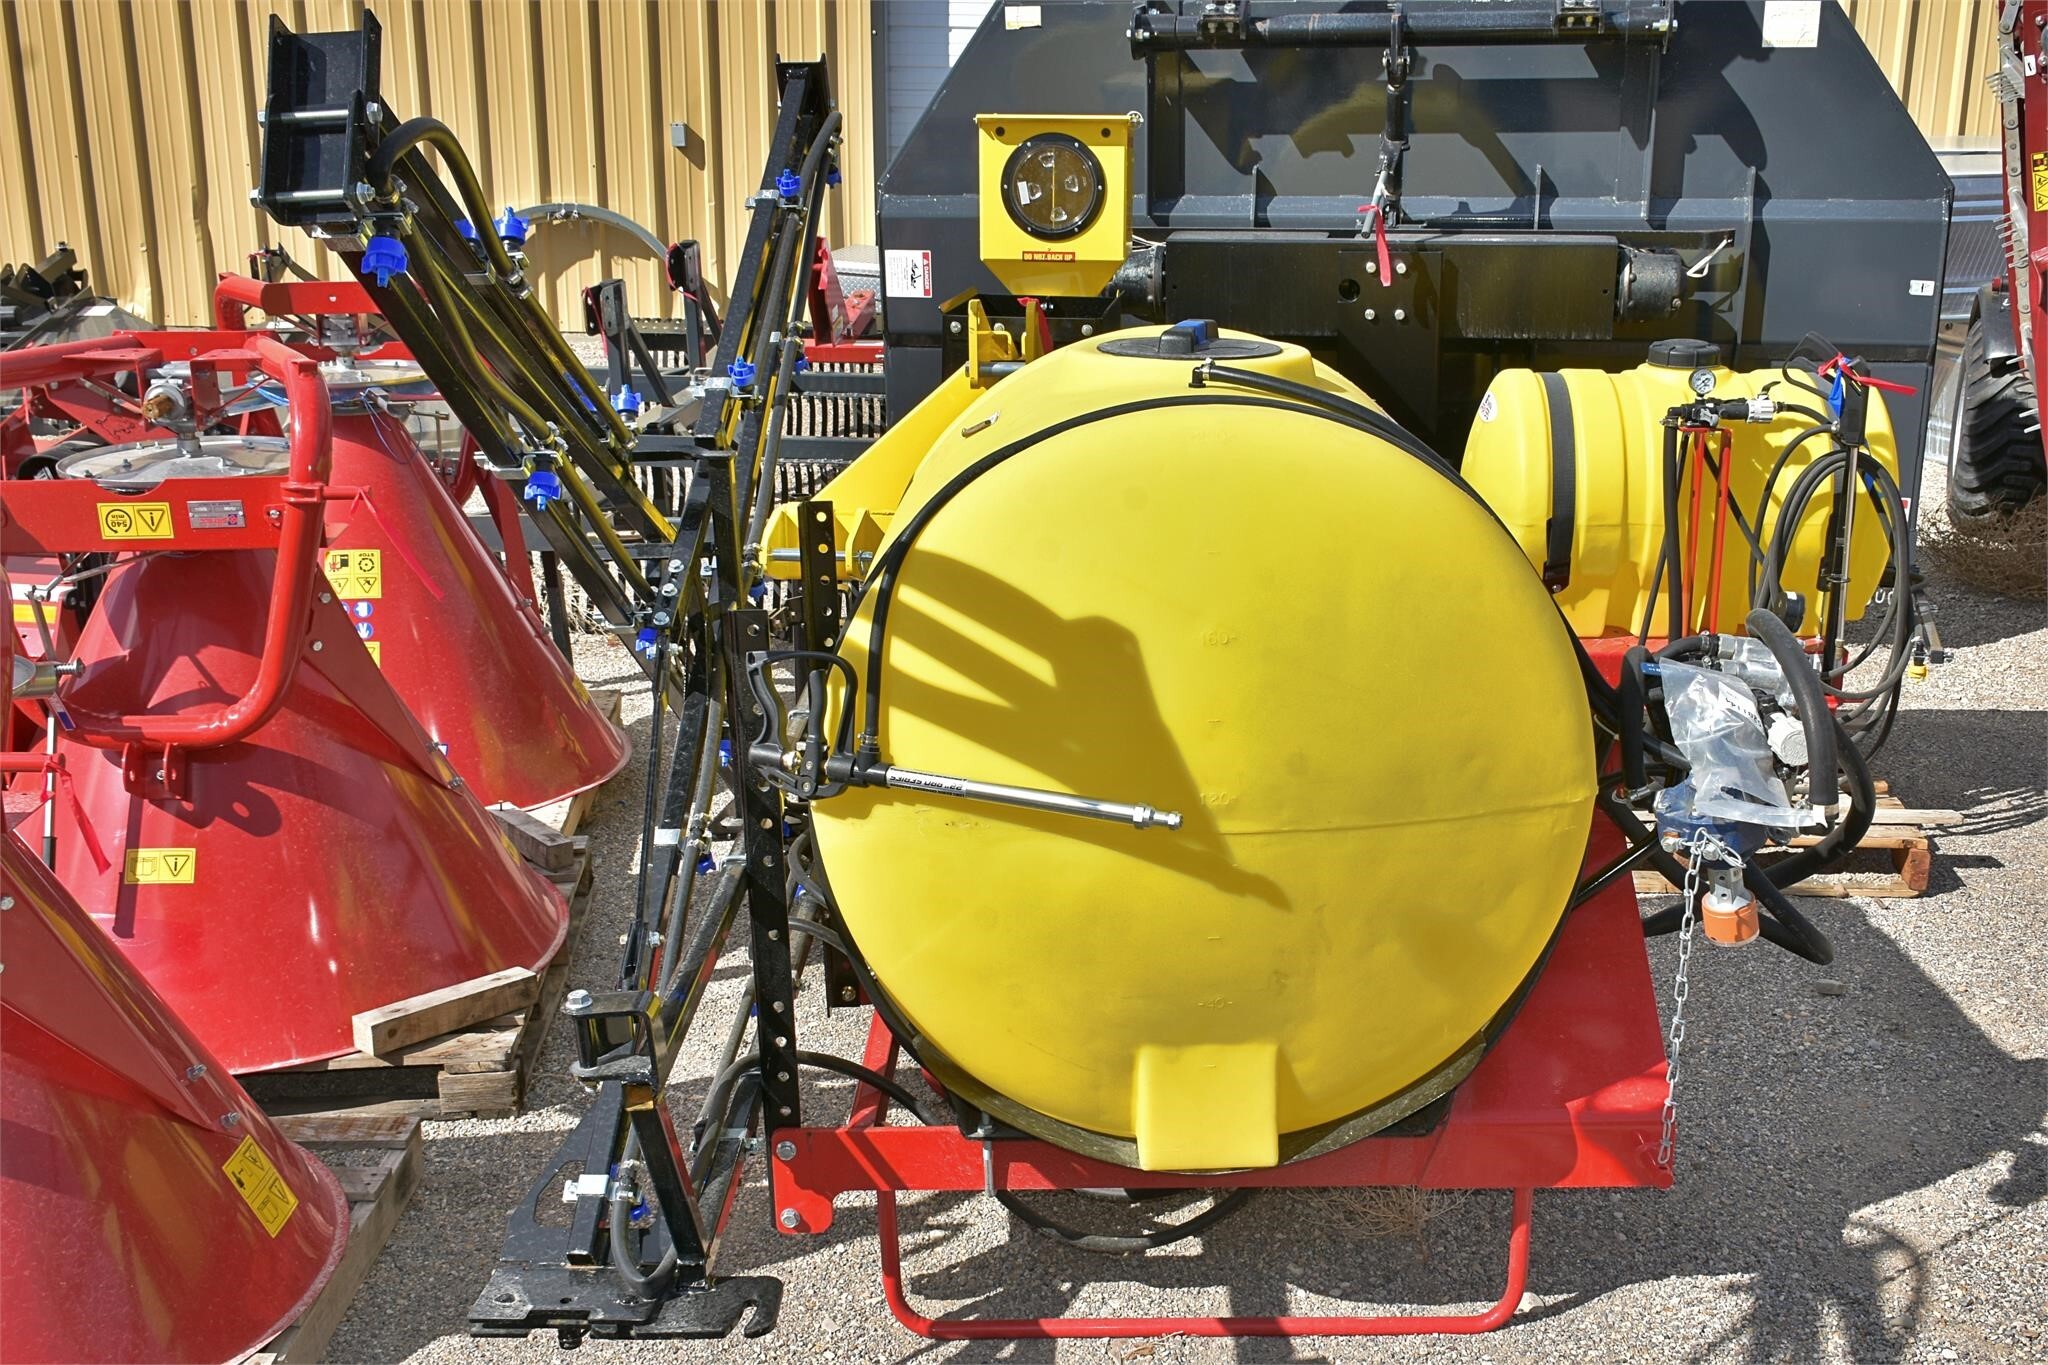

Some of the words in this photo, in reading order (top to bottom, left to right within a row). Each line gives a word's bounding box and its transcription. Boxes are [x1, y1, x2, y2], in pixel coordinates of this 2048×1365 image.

[1046, 253, 1063, 261] BACK
[923, 265, 931, 290] DANGER
[889, 775, 923, 785] SERIES
[923, 780, 943, 788] PRO
